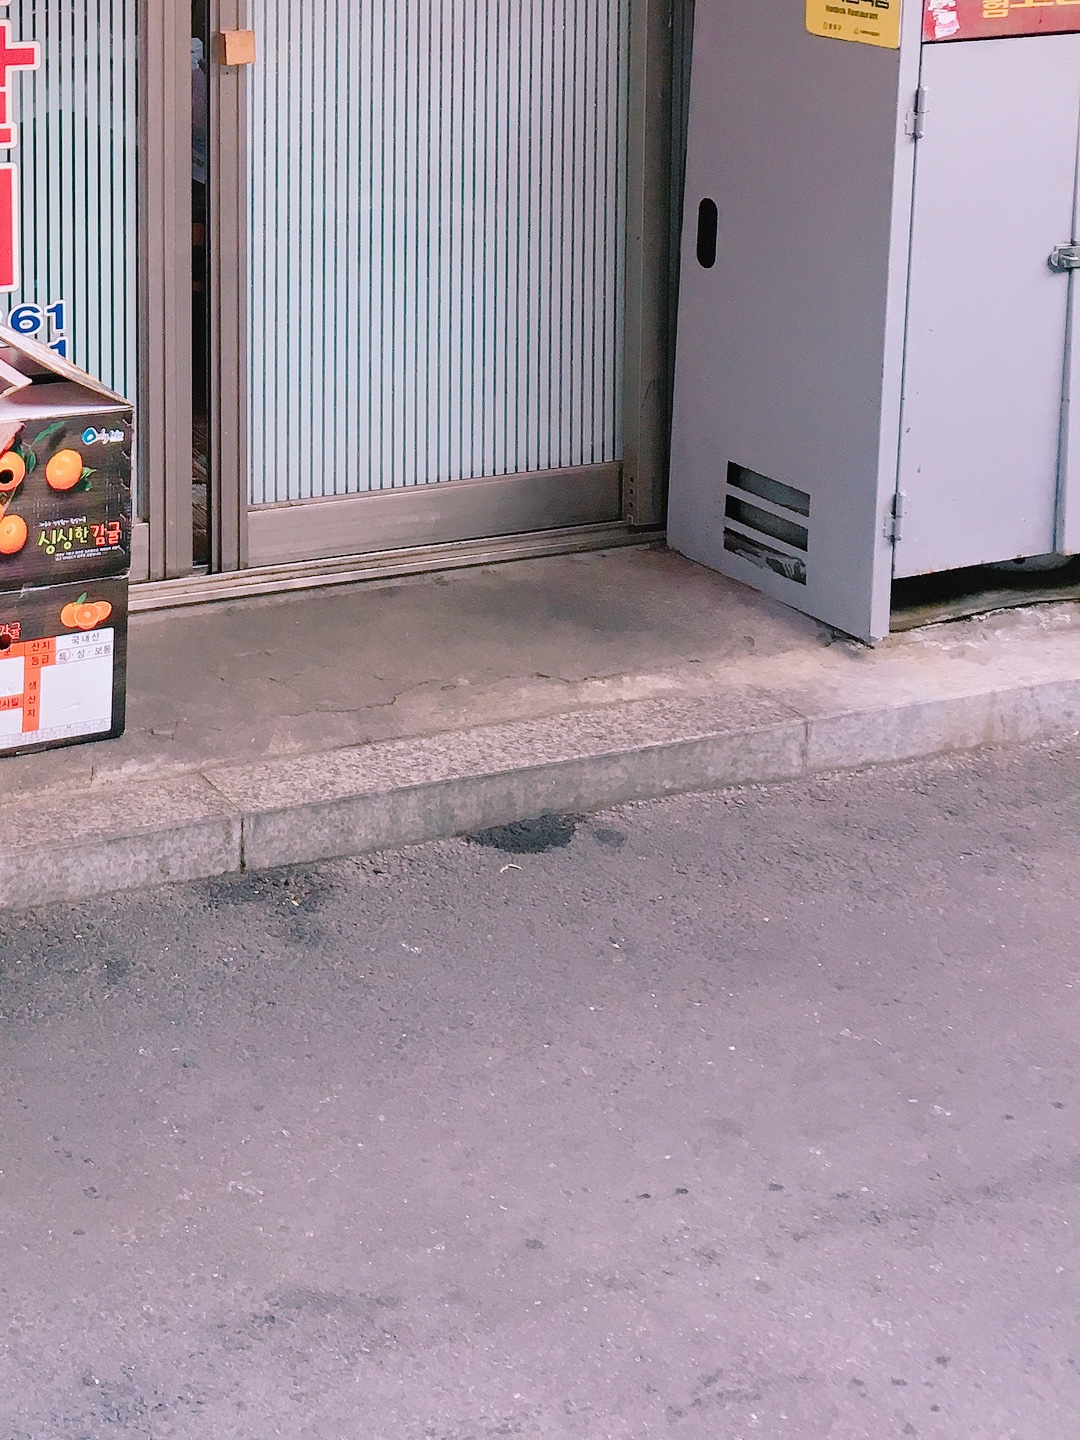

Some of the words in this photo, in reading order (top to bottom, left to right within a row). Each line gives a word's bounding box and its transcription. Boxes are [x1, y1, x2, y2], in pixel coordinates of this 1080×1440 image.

[847, 8, 879, 21] Restaurant
[37, 526, 89, 555] 싱싱한
[90, 521, 122, 546] 감귤
[31, 641, 51, 652] 산지
[71, 632, 100, 644] 국내산
[31, 654, 50, 665] 등급
[94, 644, 111, 655] 보통
